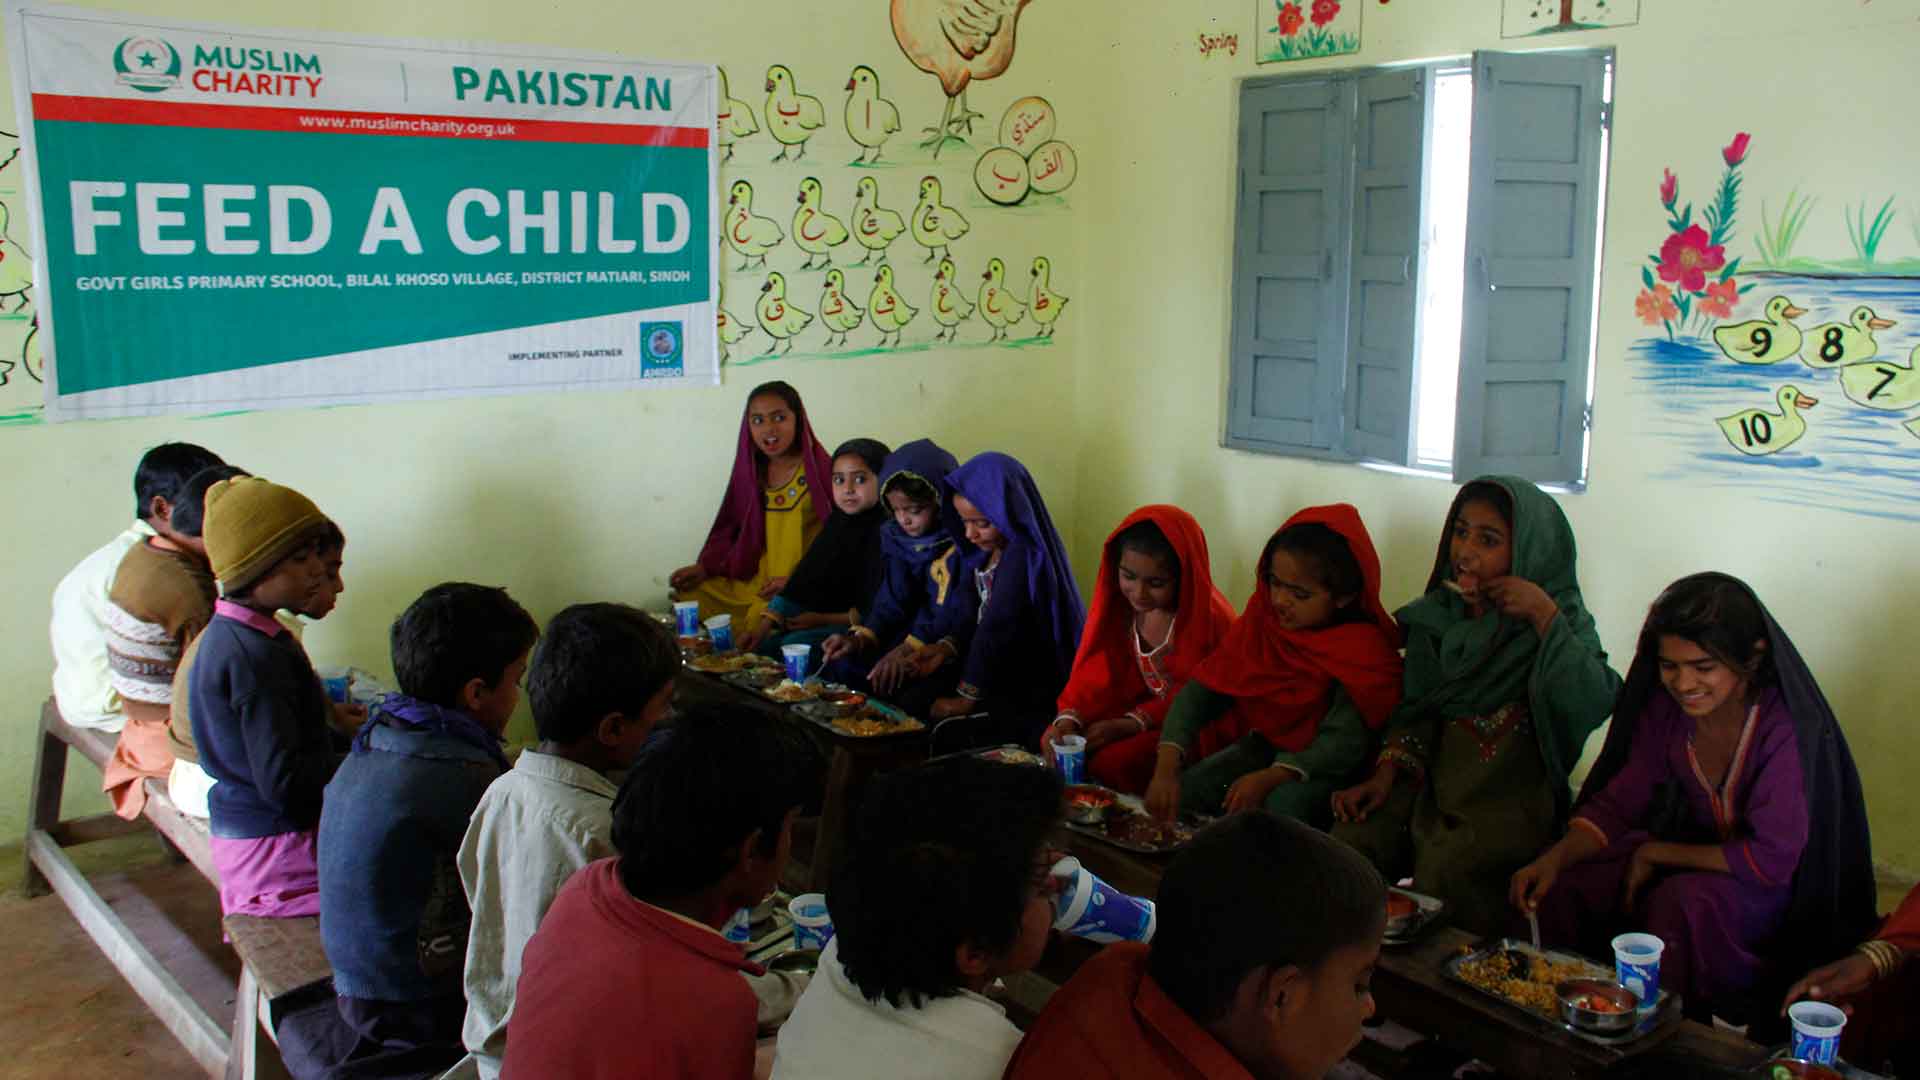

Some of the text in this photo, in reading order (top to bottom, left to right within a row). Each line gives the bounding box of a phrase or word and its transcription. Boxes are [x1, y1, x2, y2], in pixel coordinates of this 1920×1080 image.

[193, 44, 322, 74] MUSLIM
[1199, 33, 1238, 57] Spring
[192, 69, 323, 98] CHARITY
[452, 66, 672, 112] PAKISTAN
[300, 115, 516, 137] www.muslimcharity.org.uk
[69, 180, 692, 256] FEED A CHILD
[76, 270, 690, 291] GOVT GIRLS PRIMARY SCHOOL, BILAL KHOSO VILLAGE, DISTRICT MATIARI, SINDH
[508, 348, 623, 361] IMPLEMENTING PARTNER
[1750, 327, 1772, 358] 9
[1819, 326, 1844, 363] 8
[1867, 366, 1897, 400] 7
[1739, 412, 1772, 447] 10
